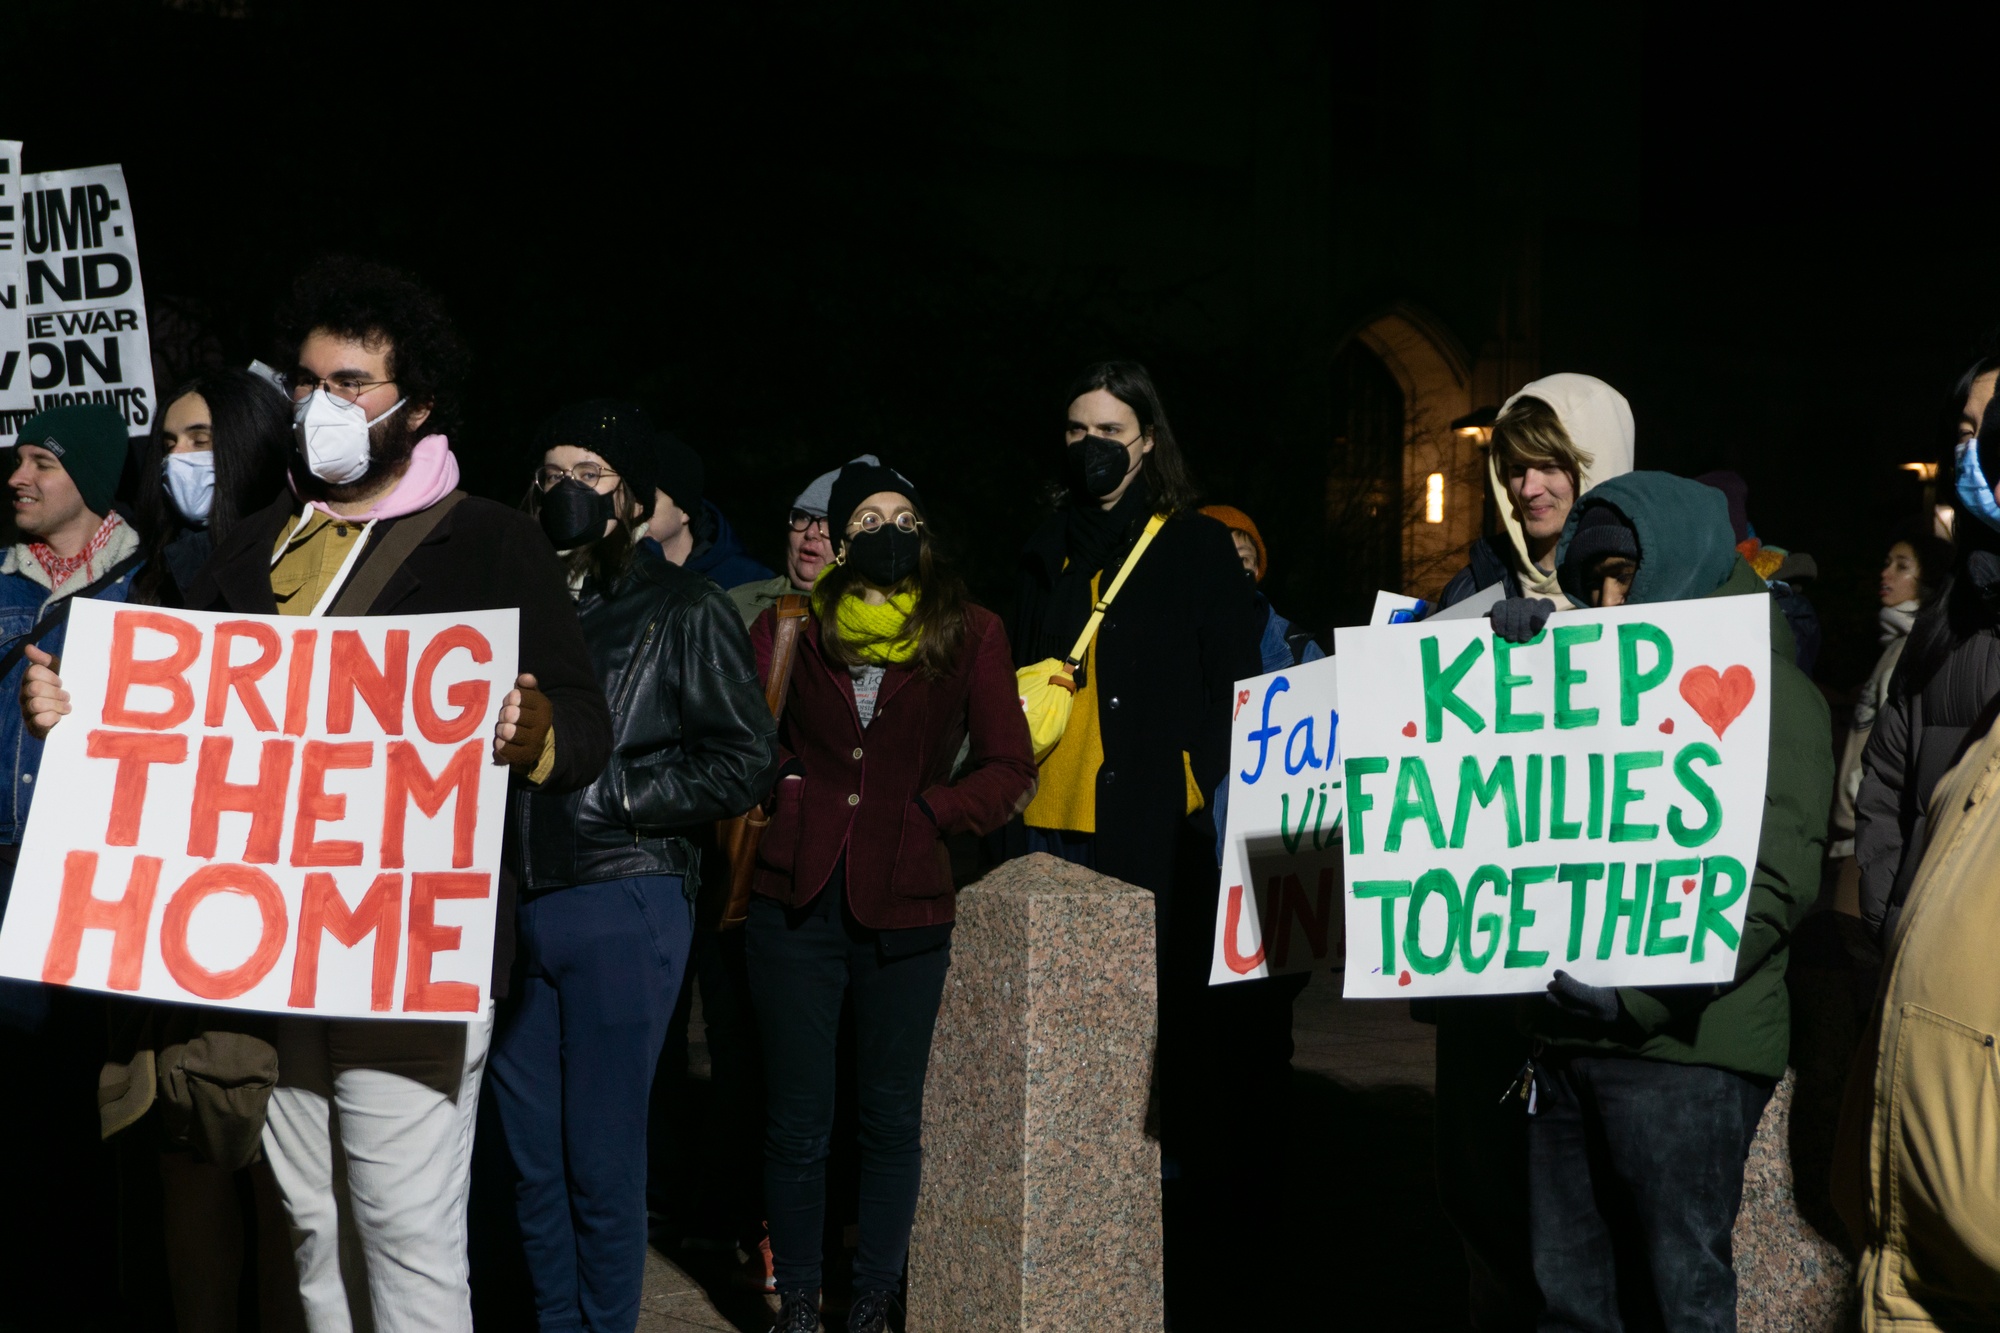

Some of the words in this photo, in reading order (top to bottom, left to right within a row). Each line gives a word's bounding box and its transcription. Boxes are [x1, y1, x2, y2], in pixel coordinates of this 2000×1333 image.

[23, 183, 124, 255] UMP:
[26, 252, 133, 306] ND
[56, 308, 139, 336] WAR
[28, 336, 123, 390] ON
[102, 610, 493, 745] BRING
[1420, 622, 1675, 744] KEEP
[86, 729, 485, 869] THEM
[1344, 742, 1723, 855] FAMILIES
[42, 850, 492, 1013] HOME
[1223, 867, 1345, 975] UN
[1352, 855, 1748, 976] TOGETHER
